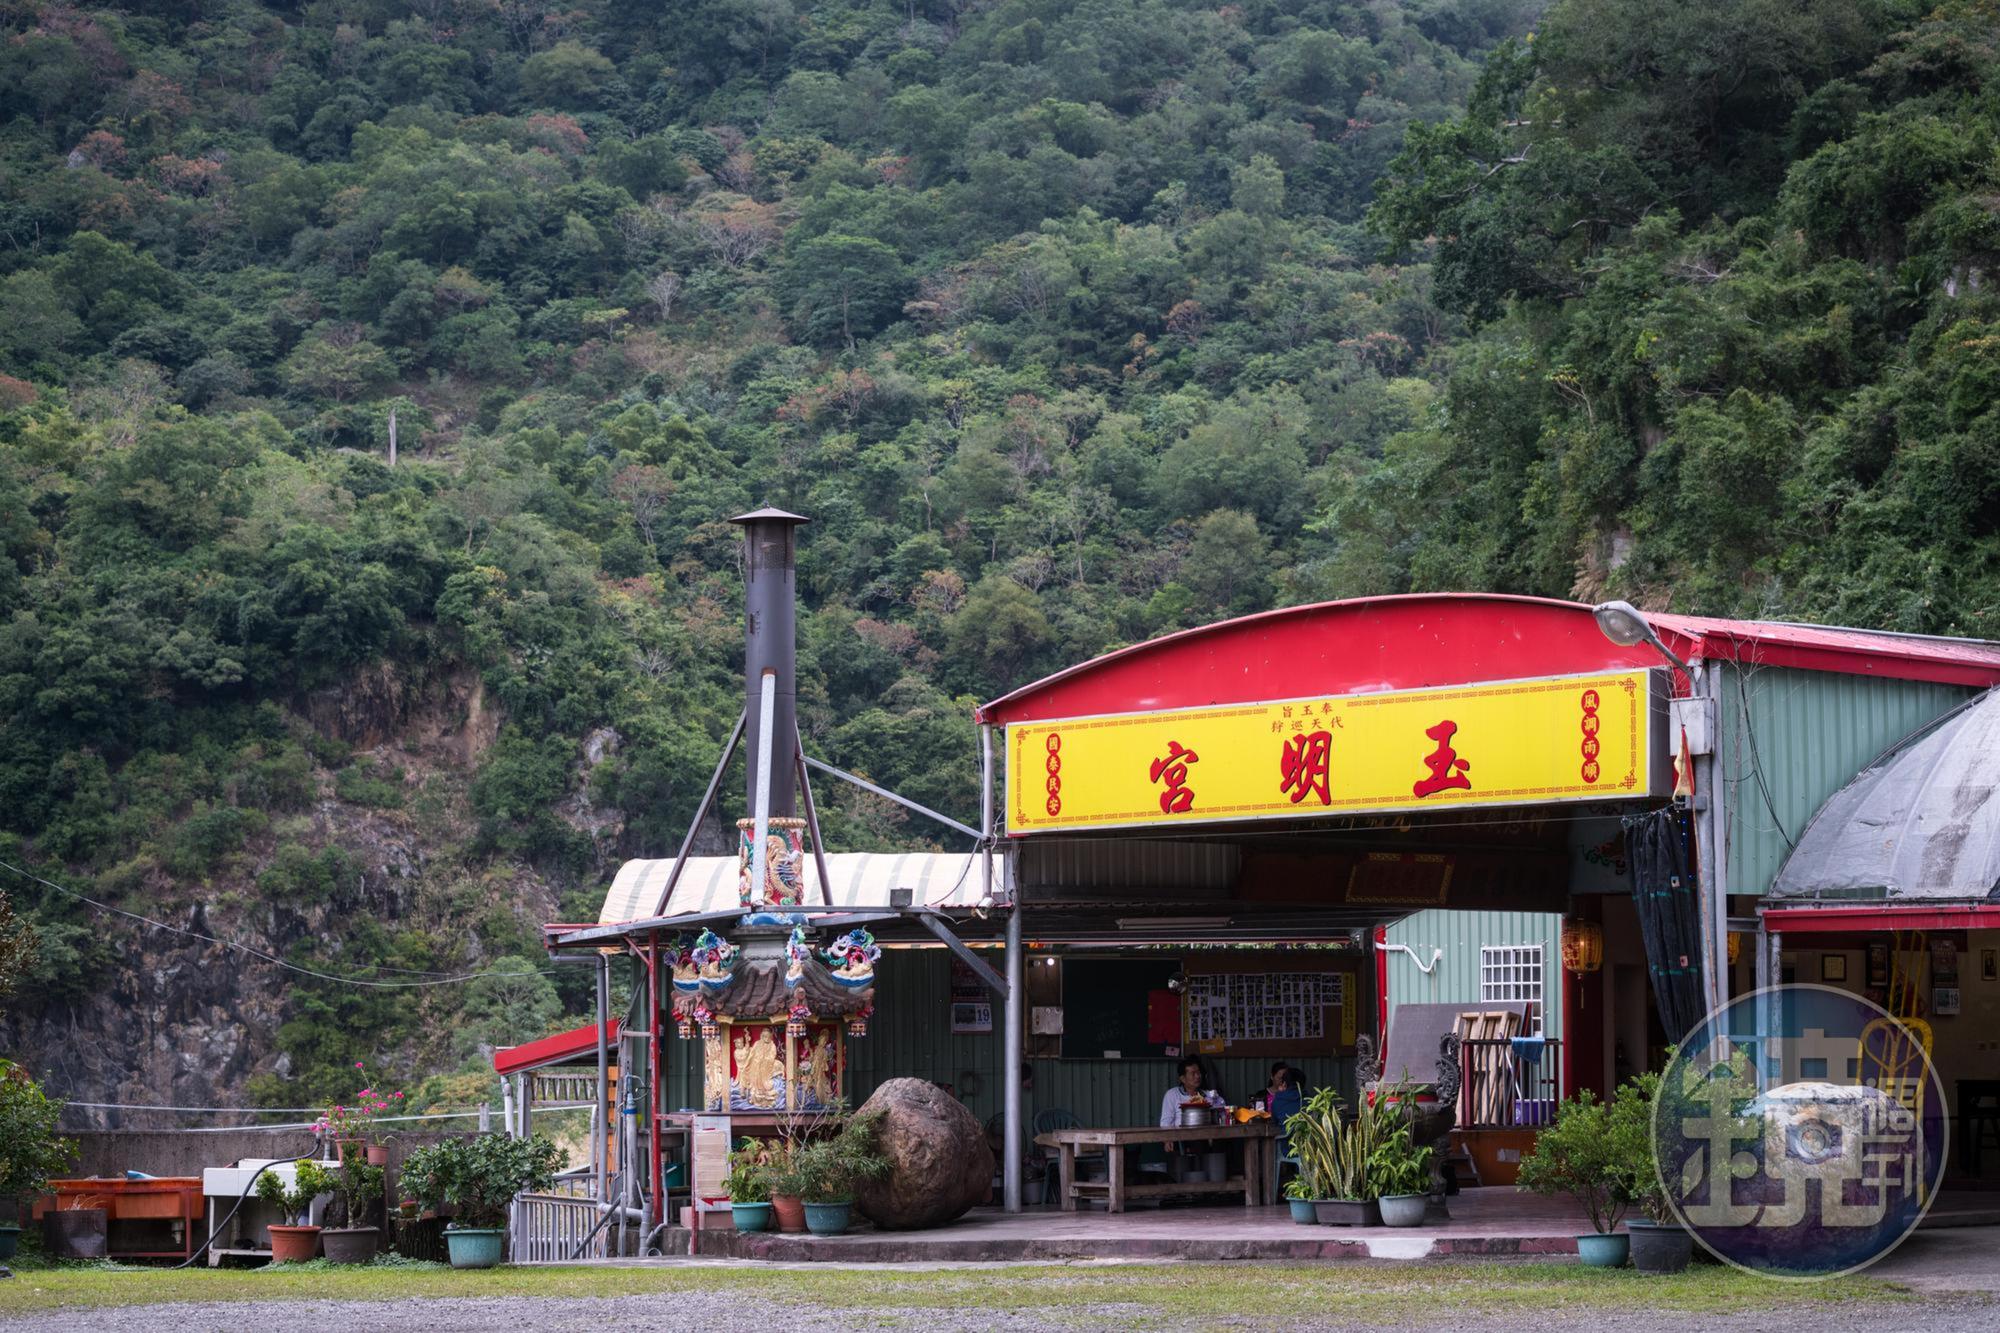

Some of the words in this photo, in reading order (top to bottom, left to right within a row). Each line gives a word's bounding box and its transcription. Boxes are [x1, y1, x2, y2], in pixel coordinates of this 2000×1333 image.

[1271, 716, 1344, 733] 代天巡狩
[1282, 702, 1333, 718] 奉玉旨
[1583, 692, 1598, 780] 風調雨順
[1048, 735, 1060, 813] 國泰民安
[1150, 719, 1472, 814] 玉明宮
[977, 1008, 990, 1022] 19
